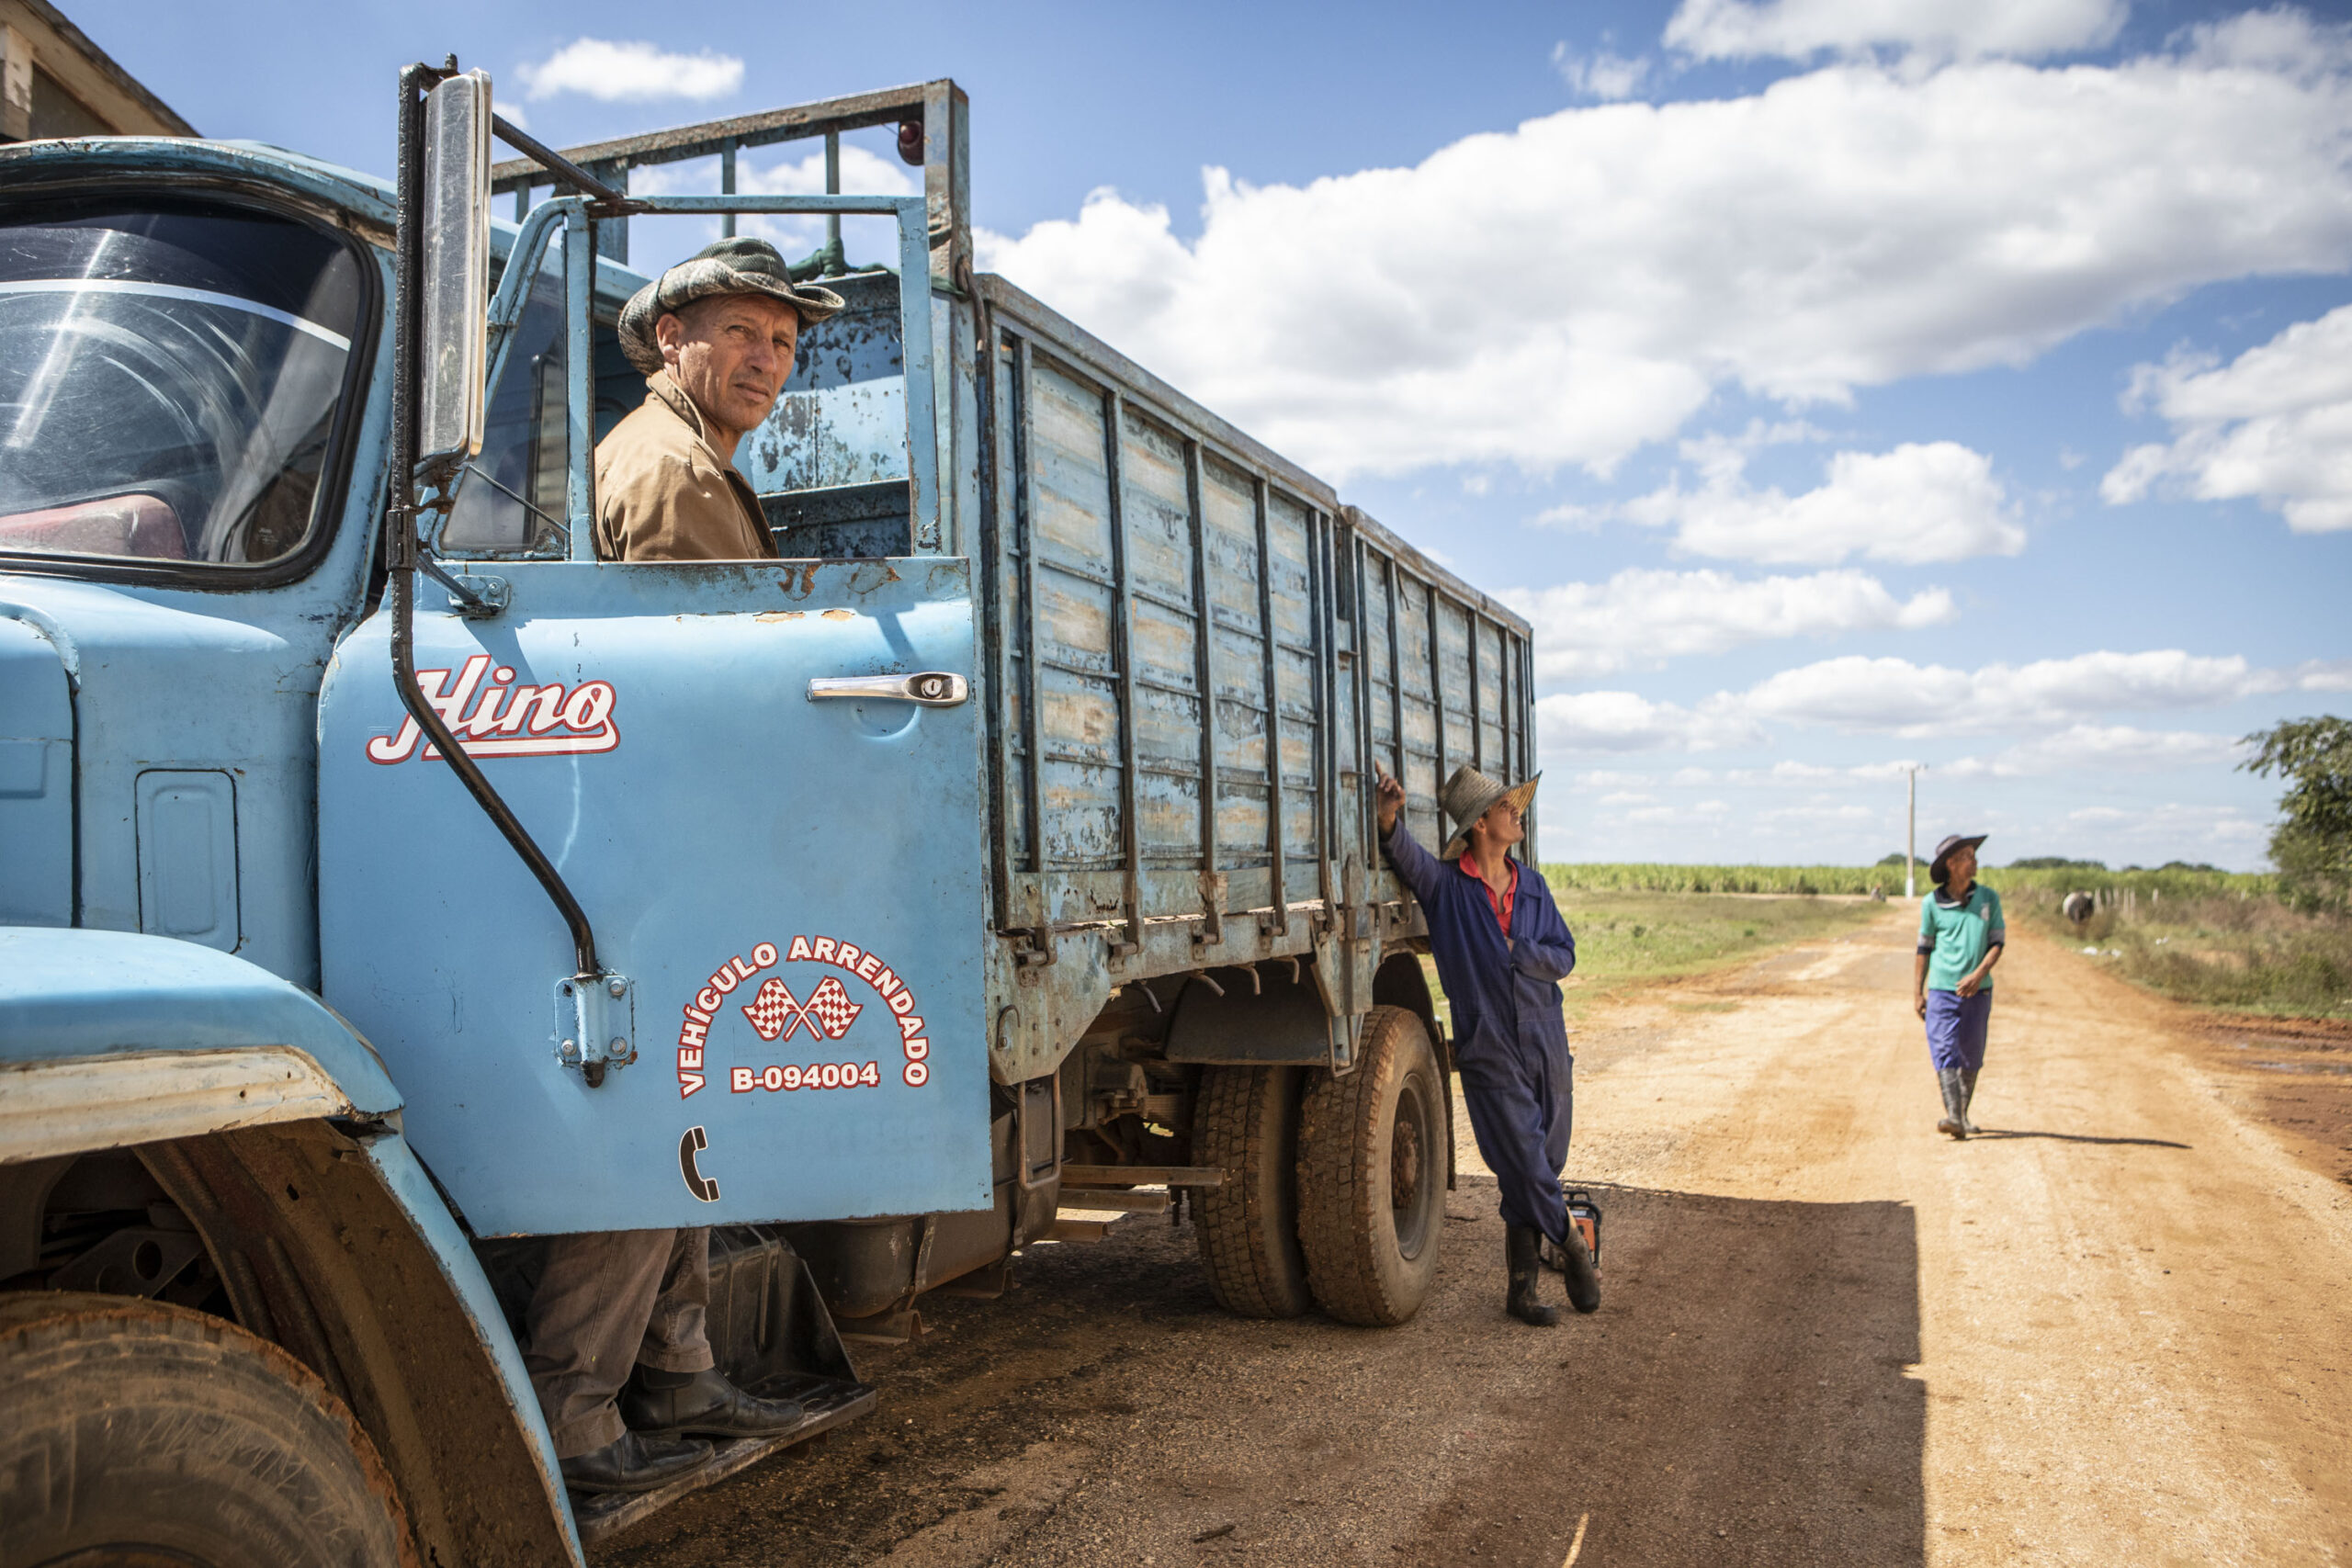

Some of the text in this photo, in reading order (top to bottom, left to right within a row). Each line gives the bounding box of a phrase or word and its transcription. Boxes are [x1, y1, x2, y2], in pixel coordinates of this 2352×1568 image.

[366, 655, 620, 765] Hino
[677, 935, 930, 1100] VEHÍCULO ARRENDADO
[730, 1061, 880, 1093] B-094004
